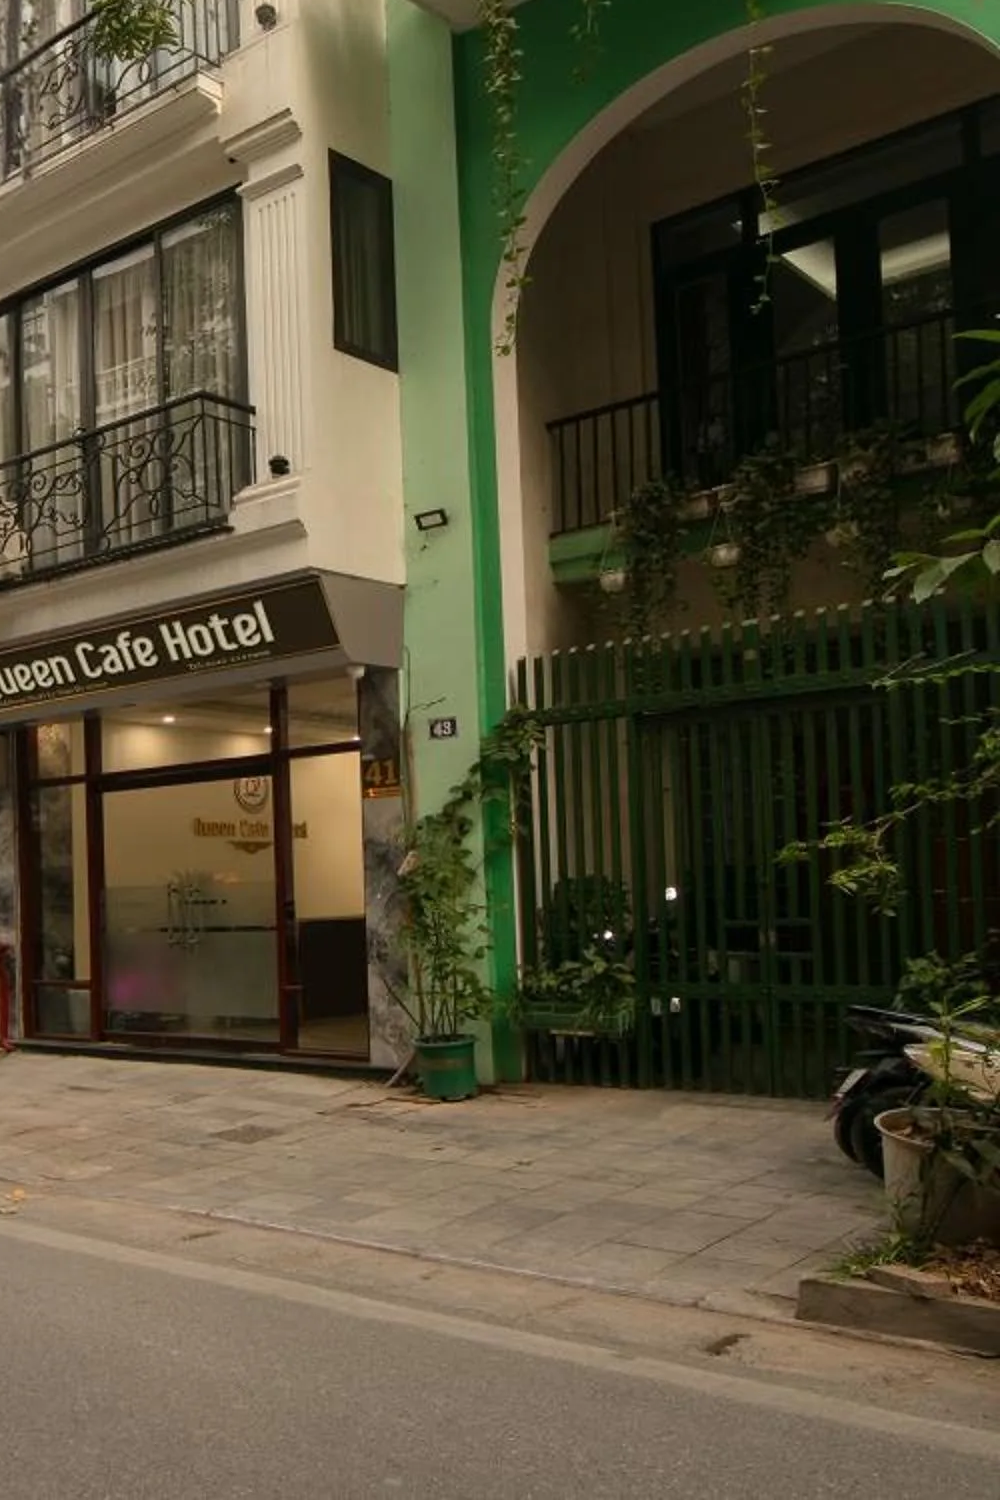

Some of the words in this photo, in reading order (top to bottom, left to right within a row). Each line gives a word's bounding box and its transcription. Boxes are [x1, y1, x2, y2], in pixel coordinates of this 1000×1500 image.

[74, 631, 159, 679] Cafe
[159, 601, 275, 661] Hotel
[364, 760, 398, 786] 41
